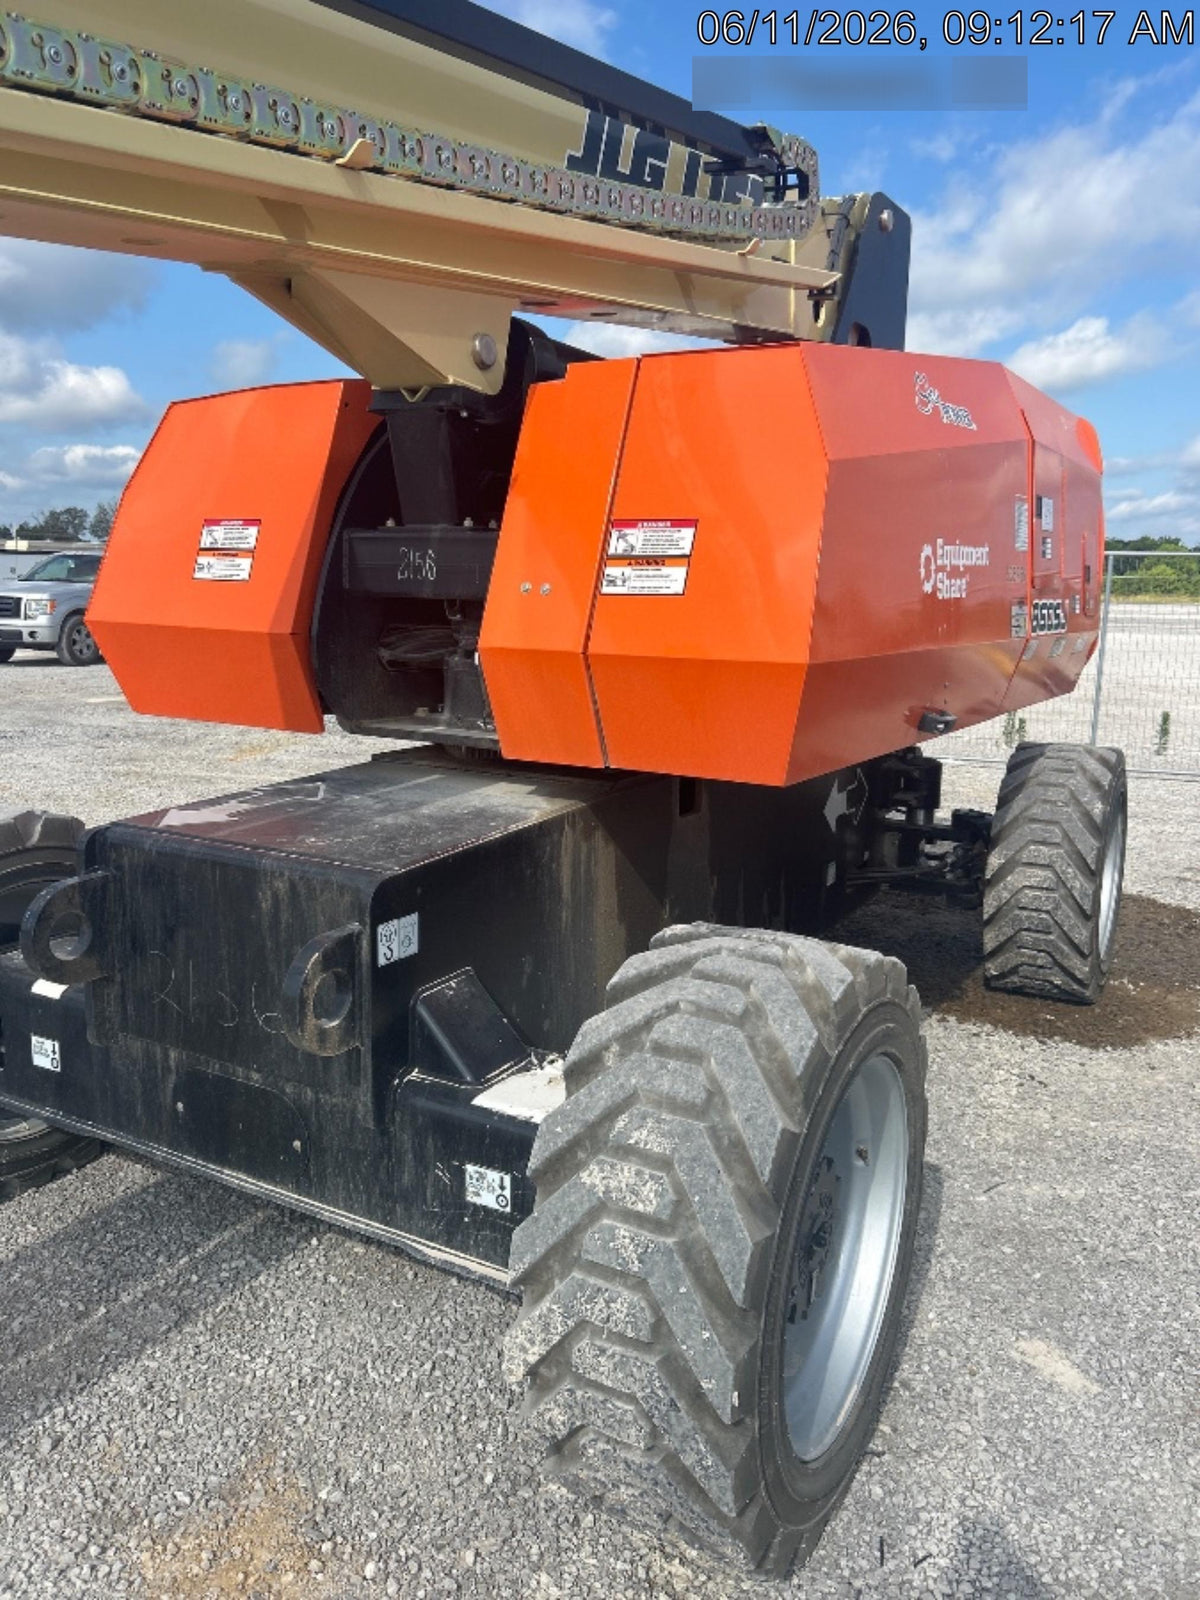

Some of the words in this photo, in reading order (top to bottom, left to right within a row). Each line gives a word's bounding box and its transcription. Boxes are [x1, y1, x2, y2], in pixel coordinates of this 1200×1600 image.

[565, 109, 672, 191] JLG
[397, 546, 437, 581] 2156
[936, 538, 989, 571] Equipment
[936, 572, 967, 600] Share
